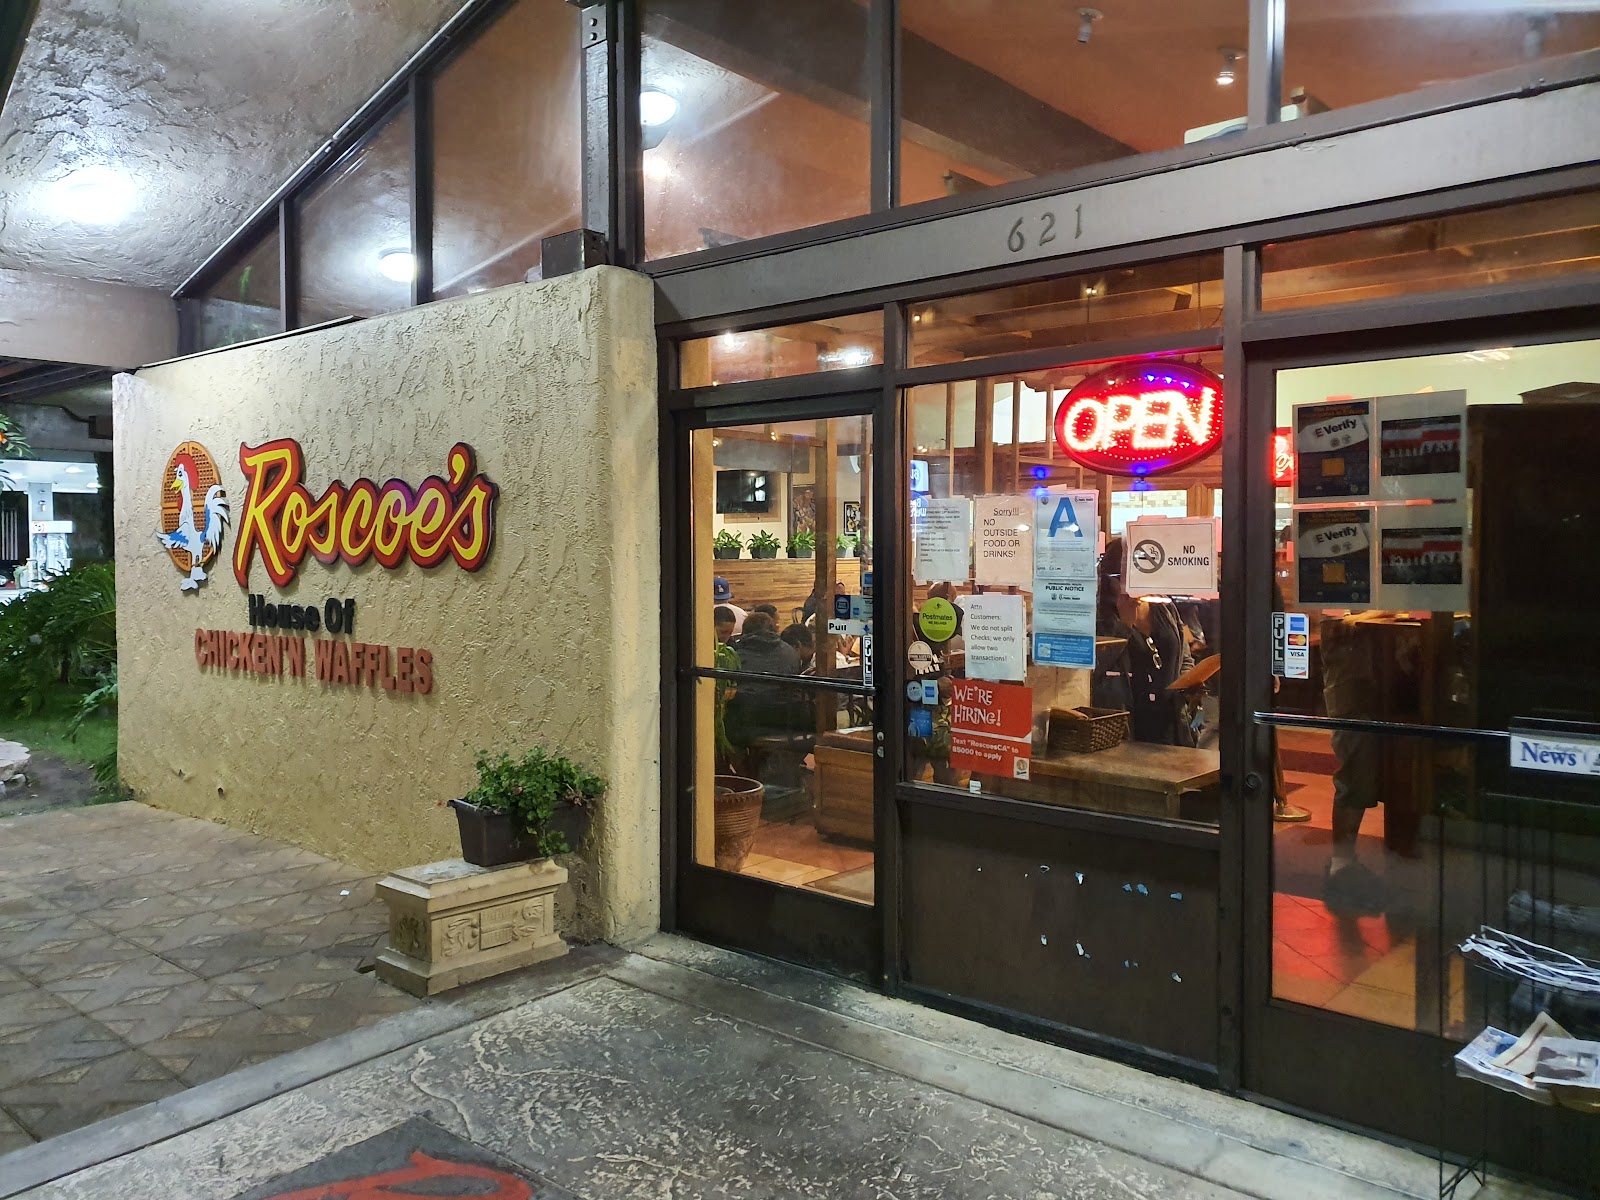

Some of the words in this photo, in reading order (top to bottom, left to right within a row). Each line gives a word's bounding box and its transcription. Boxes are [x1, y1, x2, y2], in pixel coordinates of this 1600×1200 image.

[1008, 204, 1082, 252] 621
[1064, 387, 1216, 452] OPEN
[233, 438, 499, 588] Roscoe's
[1047, 496, 1083, 537] A
[983, 518, 996, 526] NO
[983, 529, 1018, 537] OUTSIDE
[983, 550, 1016, 558] DRINKS!
[1183, 545, 1195, 555] NO
[1167, 556, 1210, 567] SMOKING
[248, 593, 320, 632] House
[324, 597, 355, 634] Of
[922, 612, 953, 621] Postmates
[828, 622, 847, 631] Pull
[1000, 625, 1013, 633] split
[1002, 635, 1015, 643] only
[1273, 617, 1284, 661] PULL
[194, 628, 306, 679] CHICKEN'N
[315, 639, 433, 695] WAFFLES
[971, 654, 1007, 662] transactions!
[953, 685, 993, 706] WE'RE
[952, 737, 966, 745] Text
[952, 746, 974, 755] 85000
[983, 752, 1002, 761] apply
[1520, 741, 1577, 767] News
